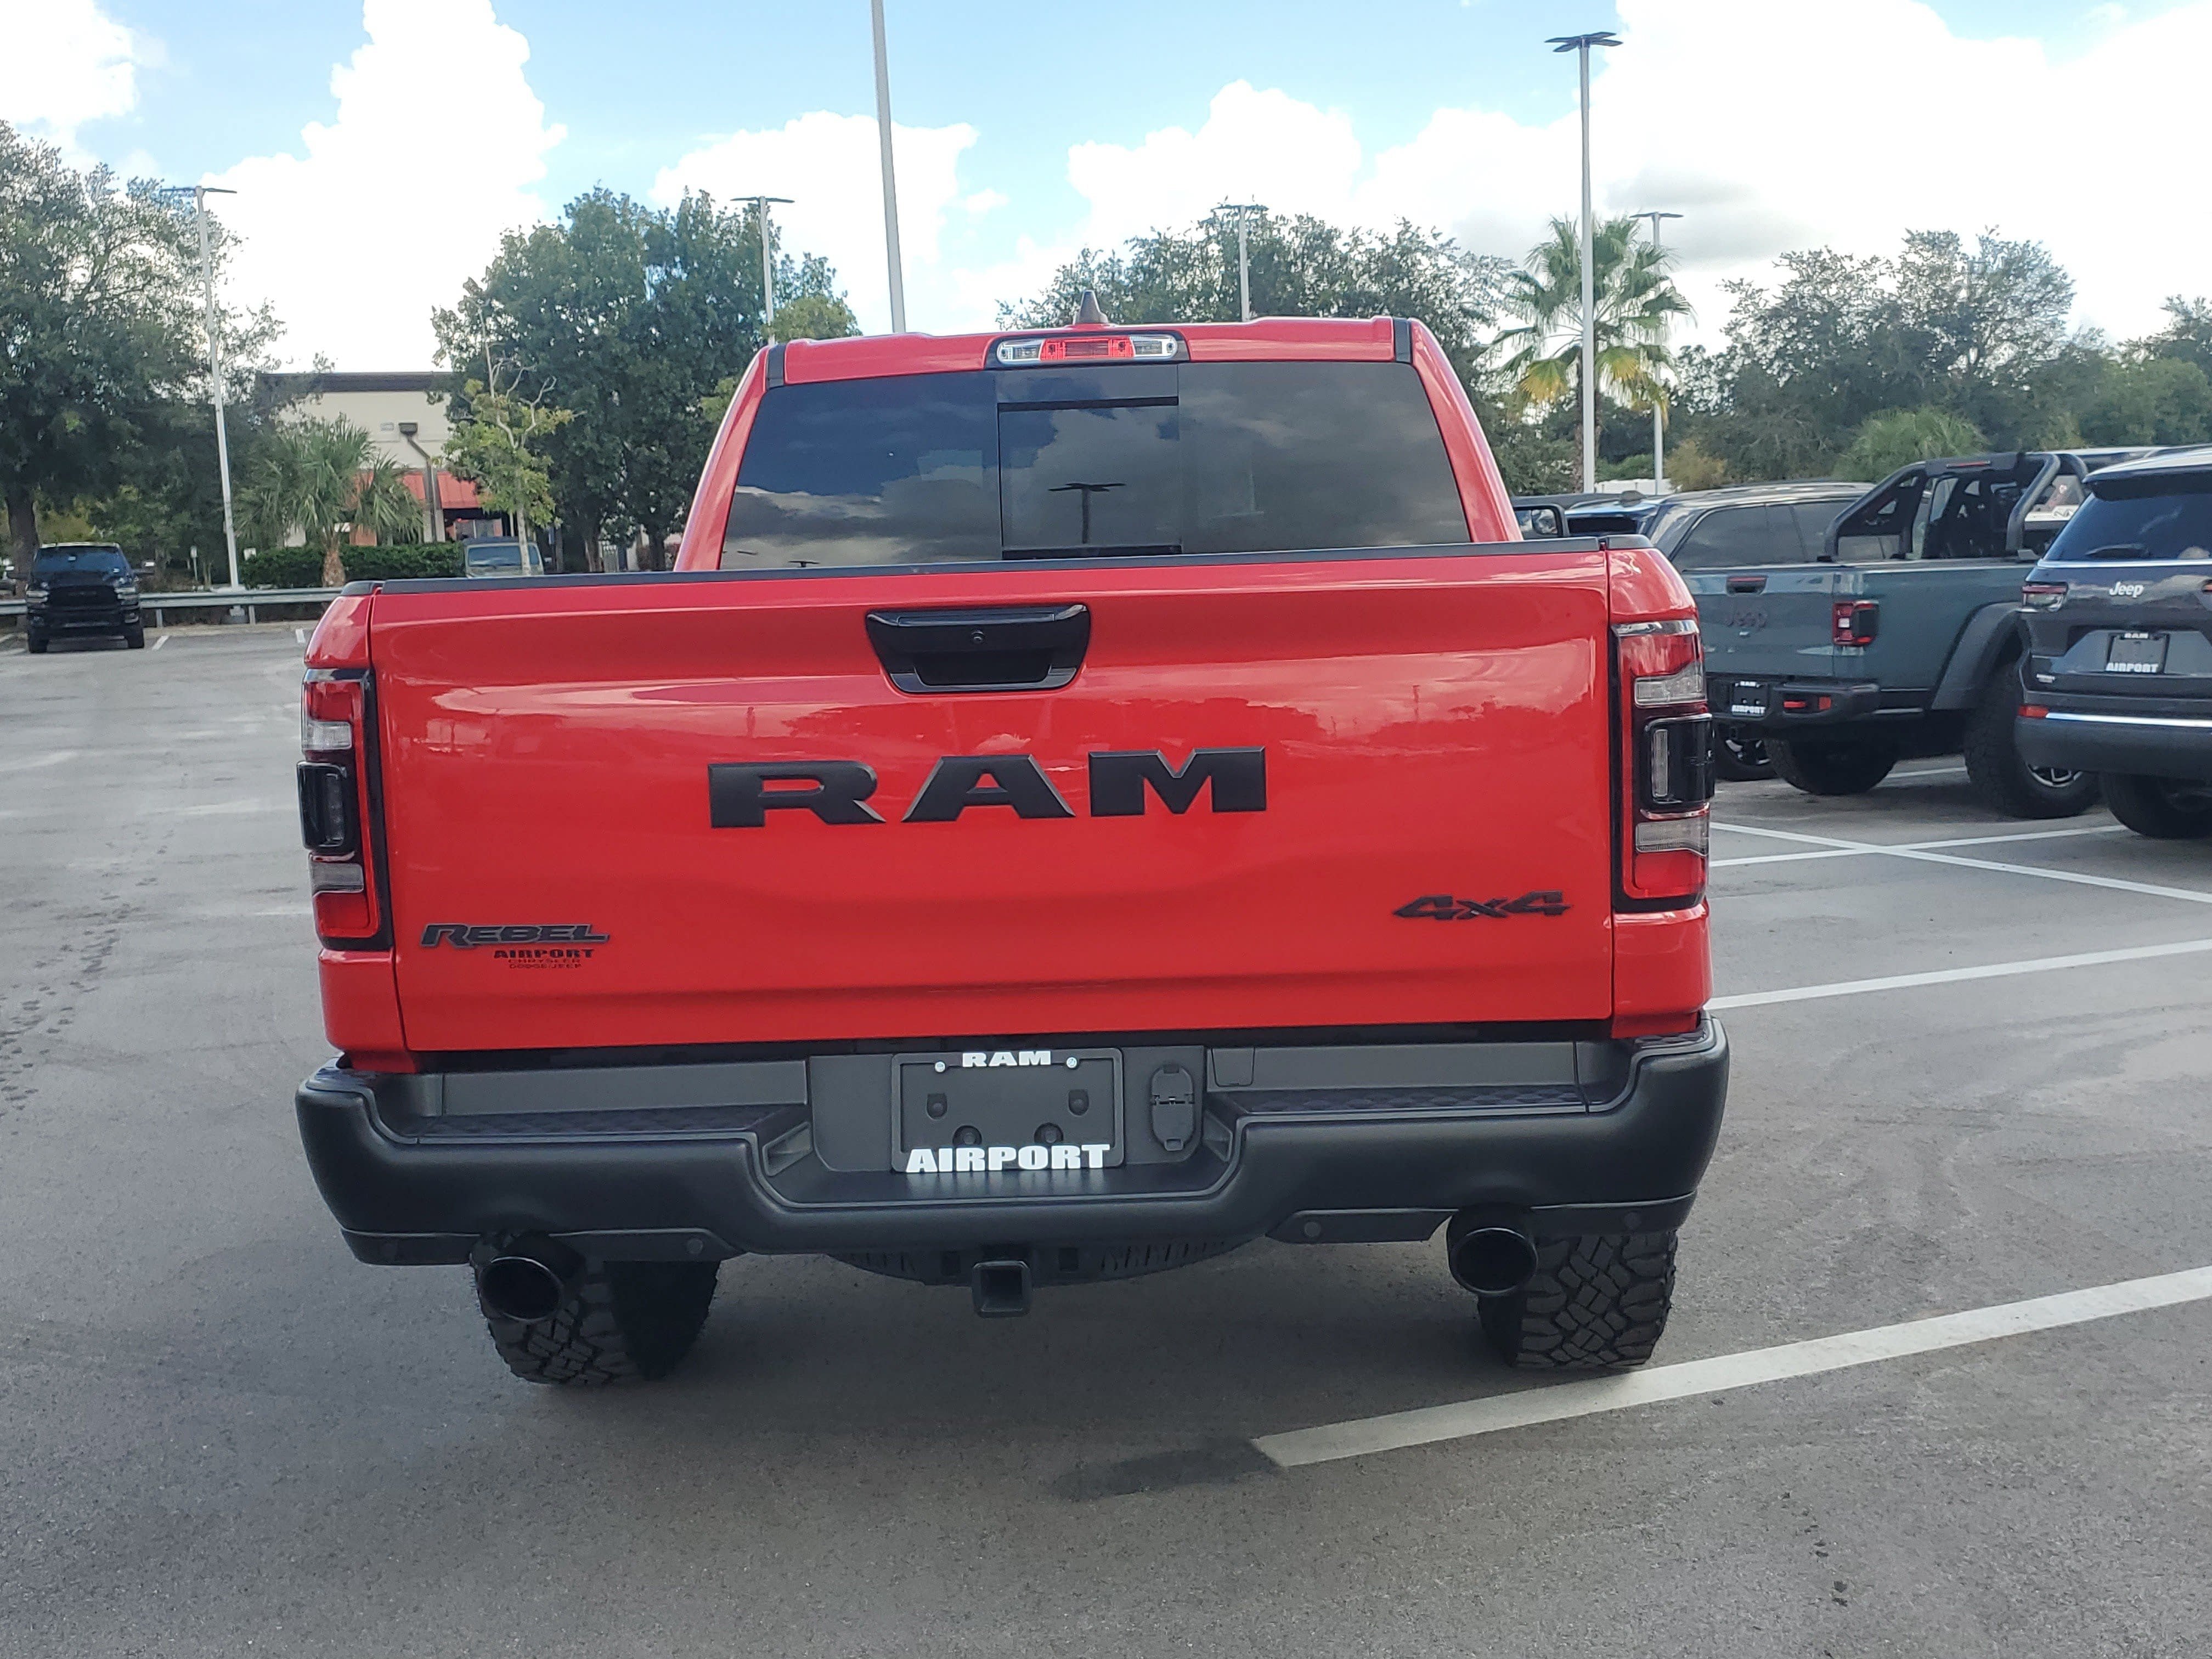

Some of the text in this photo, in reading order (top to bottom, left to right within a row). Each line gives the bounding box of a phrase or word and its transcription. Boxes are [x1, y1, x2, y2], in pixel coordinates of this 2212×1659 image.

[2109, 582, 2145, 598] Jeep
[2106, 662, 2159, 673] AIRPORT
[708, 746, 1266, 828] RAM
[420, 922, 610, 949] REBEL
[494, 949, 594, 958] AIRPORT
[962, 1051, 1051, 1068] RAM
[906, 1144, 1110, 1173] AIRPORT
